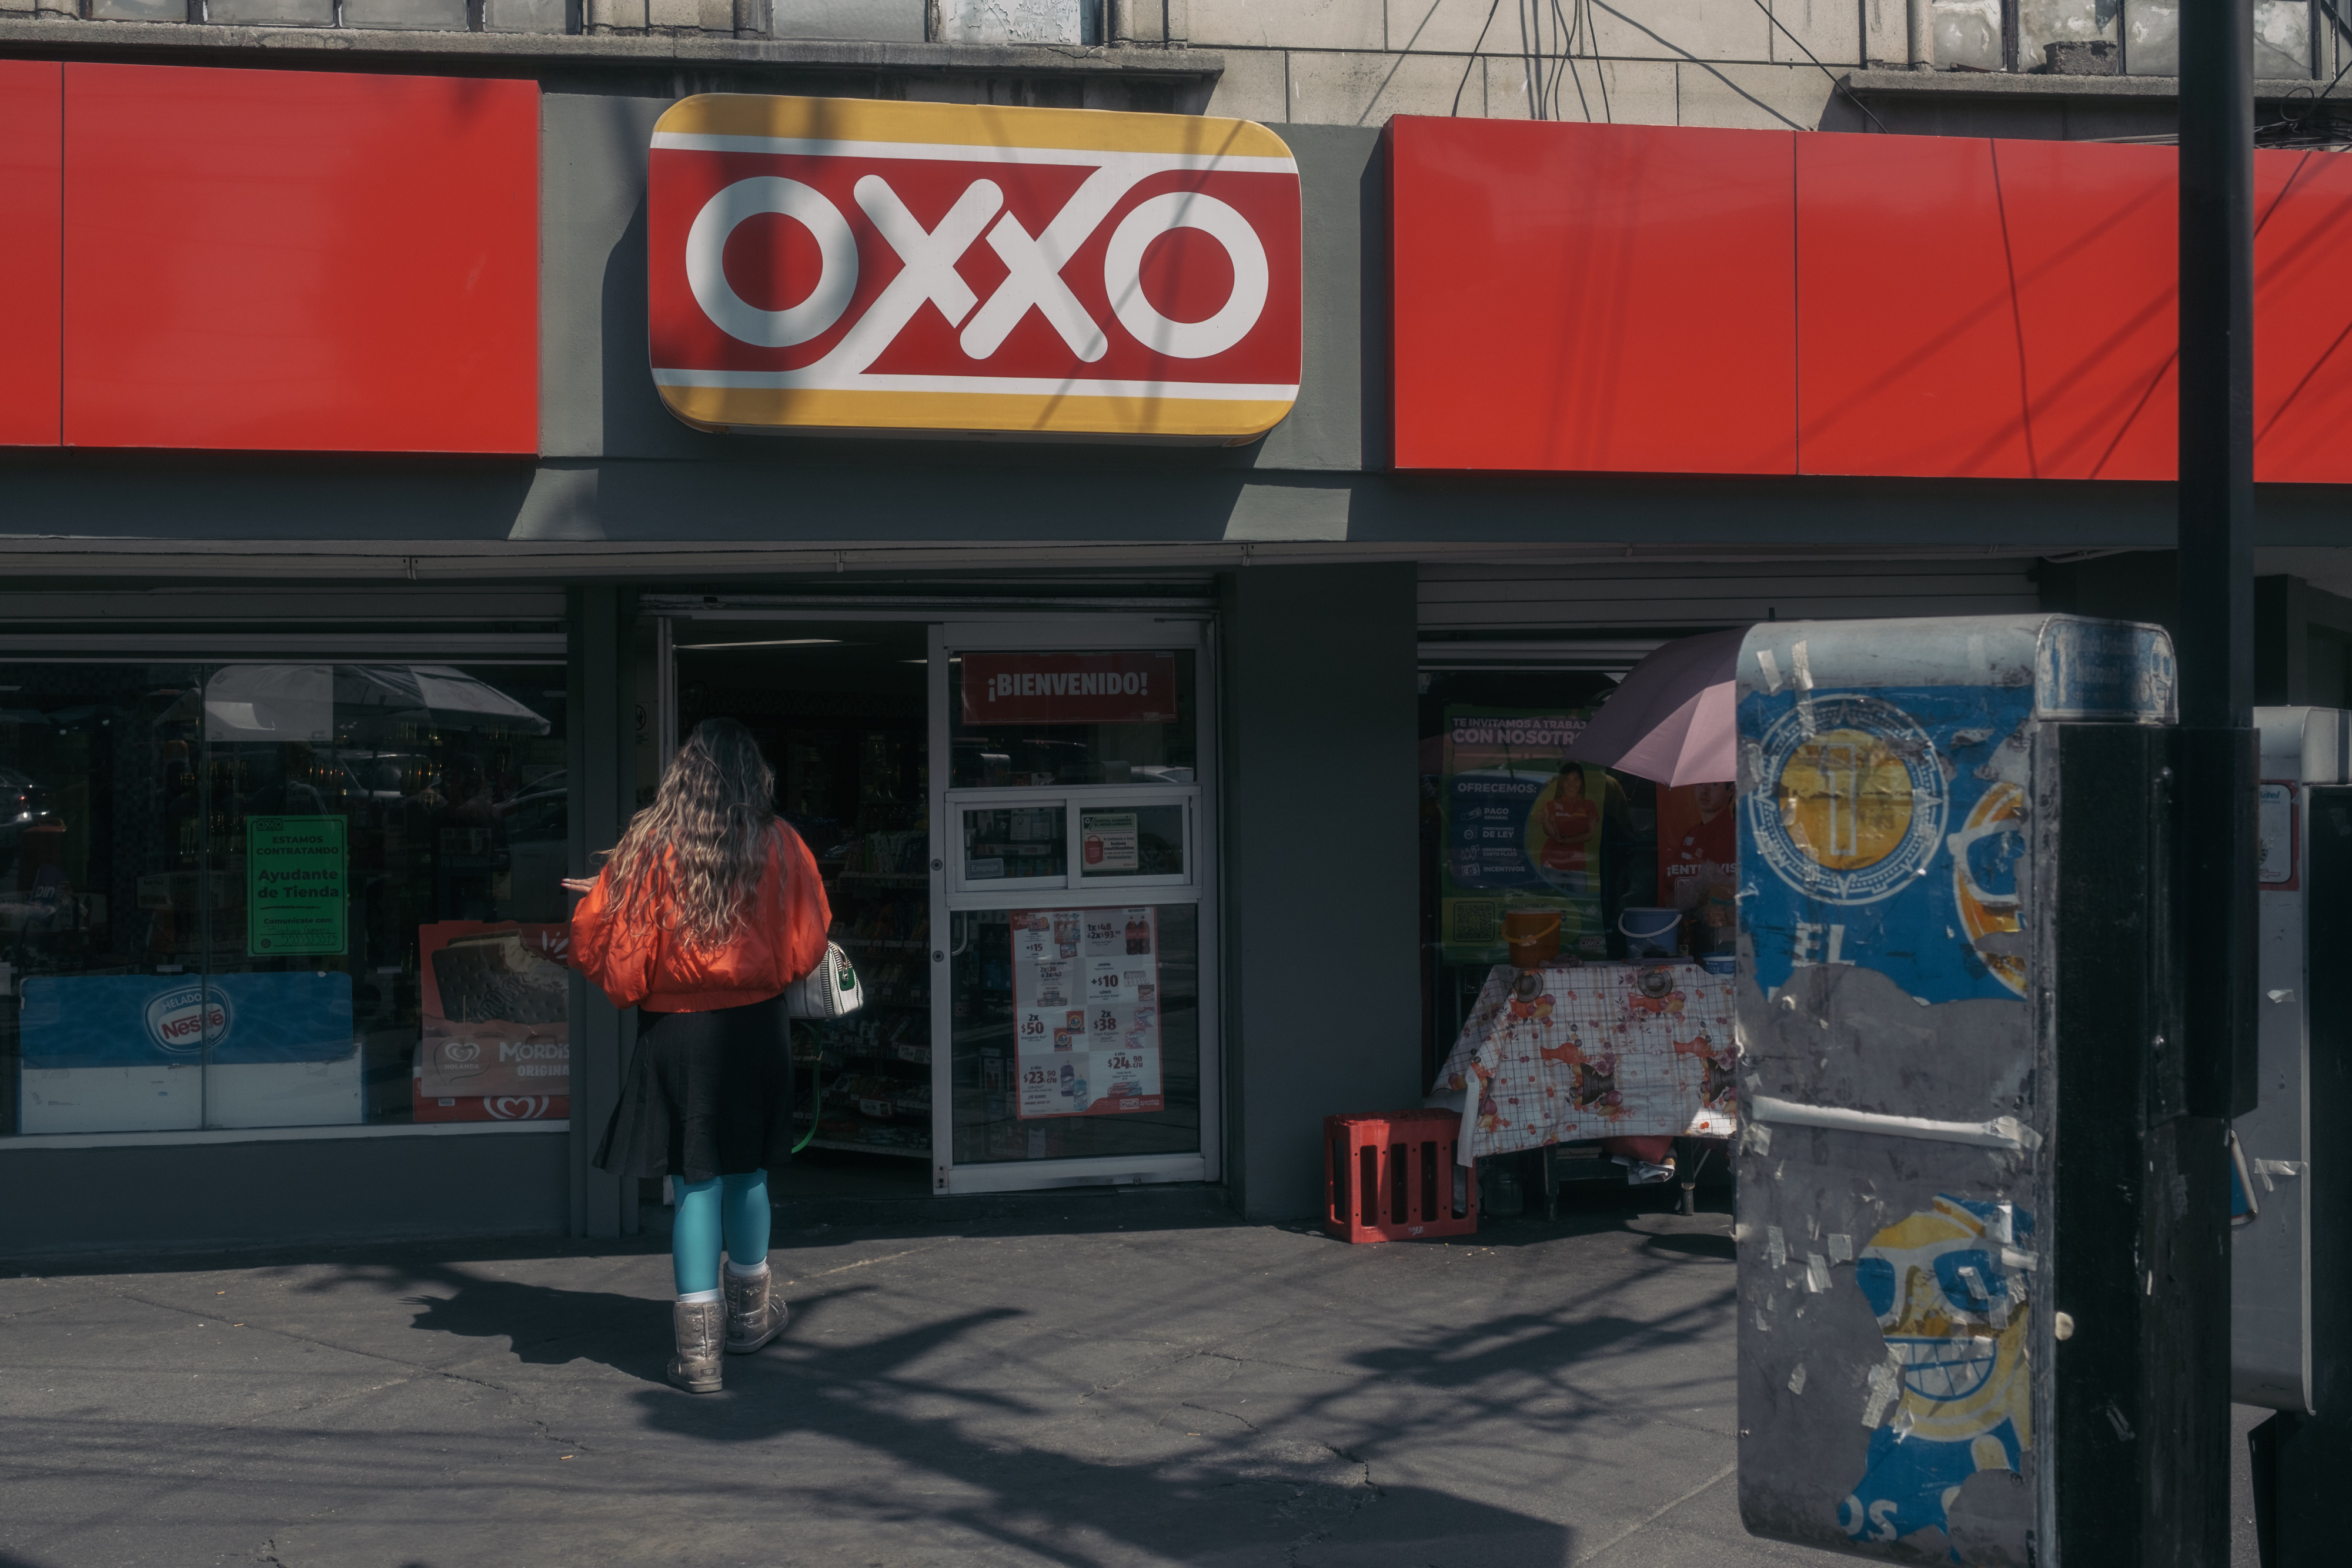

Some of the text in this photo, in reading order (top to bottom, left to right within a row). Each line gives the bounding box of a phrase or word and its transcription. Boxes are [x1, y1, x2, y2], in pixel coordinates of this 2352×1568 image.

[686, 170, 1269, 367] OXXO
[988, 672, 1148, 702] ¡BIENVENIDO!
[1452, 718, 1466, 727] TE
[1469, 719, 1531, 728] INVITAMOS
[1452, 729, 1493, 743] CON
[1458, 783, 1537, 793] OFRECEMOS:
[257, 820, 283, 830] OXXO
[272, 835, 323, 844] ESTAMOS
[256, 847, 339, 855] CONTRATANDO
[971, 864, 998, 872] Empuje
[258, 868, 338, 884] Ayudante
[258, 886, 339, 898] de Tienda
[1579, 939, 1602, 947] OXXO
[1791, 922, 1856, 967] EL
[1021, 1021, 1044, 1035] $50
[1094, 1018, 1117, 1031] $38
[1120, 1099, 1139, 1108] OXXO
